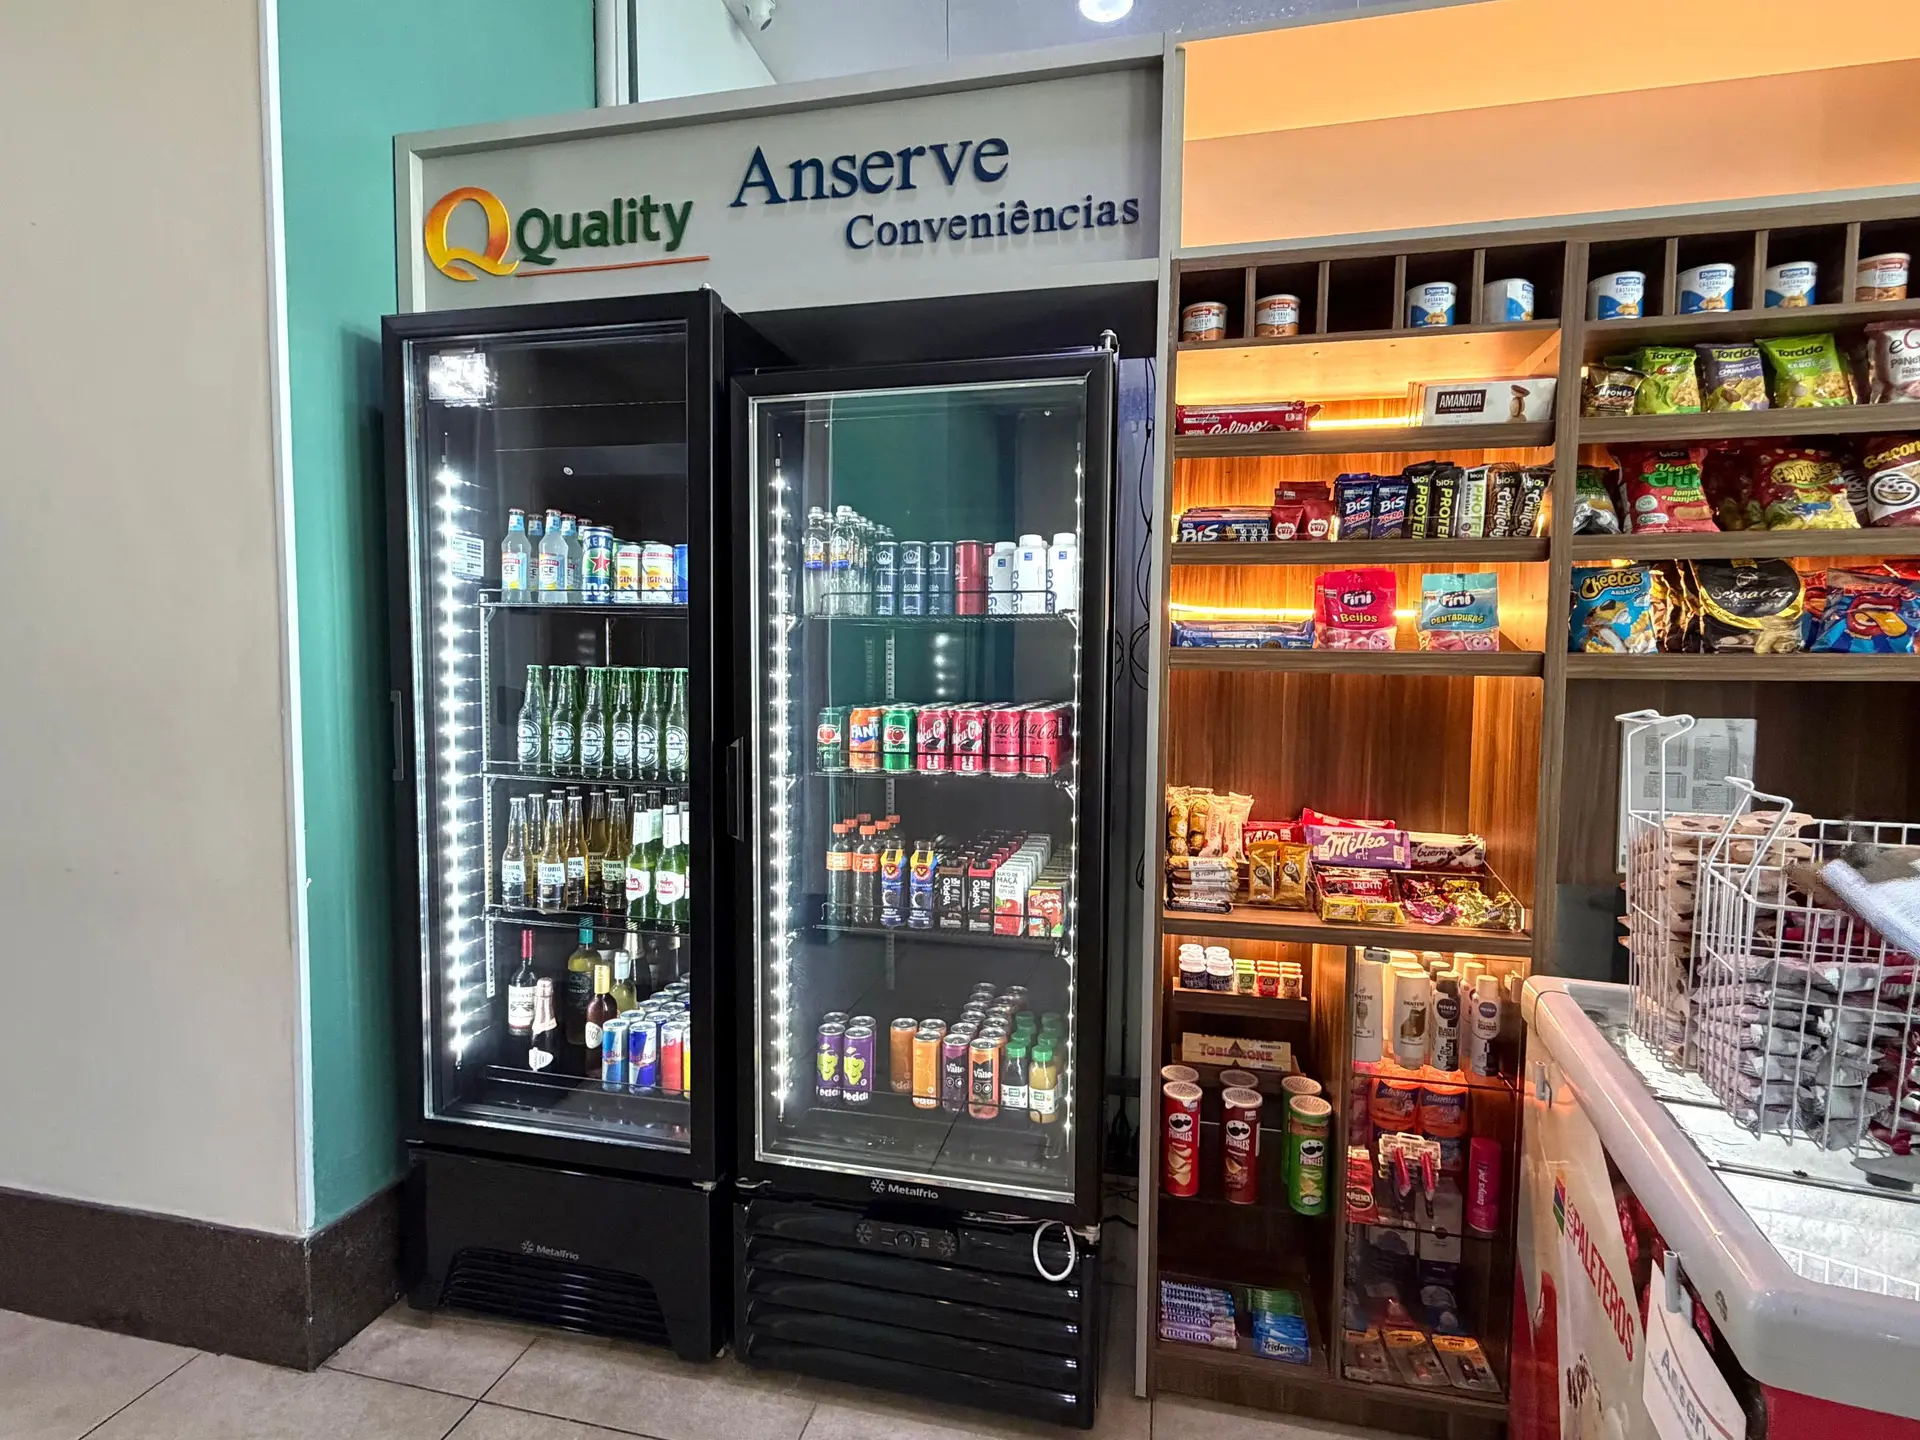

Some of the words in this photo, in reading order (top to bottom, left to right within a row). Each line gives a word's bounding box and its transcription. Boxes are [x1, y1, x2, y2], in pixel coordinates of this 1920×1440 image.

[729, 137, 1010, 208] Anserve
[515, 195, 693, 266] Quality
[845, 194, 1141, 250] Conveniências
[1439, 393, 1482, 409] AMANDITA
[1412, 485, 1428, 539] PROTEI
[1581, 571, 1643, 598] Cheetos
[1343, 590, 1374, 608] Fini
[1441, 591, 1475, 607] Fini
[1340, 613, 1379, 625] Beijos
[1429, 613, 1486, 626] DENTADURAS
[1328, 831, 1390, 859] Milka
[996, 876, 1018, 886] MAÇÃ
[1352, 880, 1383, 891] TRENTO
[943, 878, 951, 905] YoPRO
[972, 880, 981, 907] YoPRO
[1168, 1128, 1193, 1142] PRINGLES
[1225, 1133, 1250, 1151] PRINGLES
[1299, 1154, 1324, 1167] PRINGLES
[888, 1184, 939, 1199] Metalfrio
[536, 1244, 580, 1261] Metalfrio
[1571, 1219, 1635, 1362] PALETEROS
[1166, 1327, 1212, 1342] mentos
